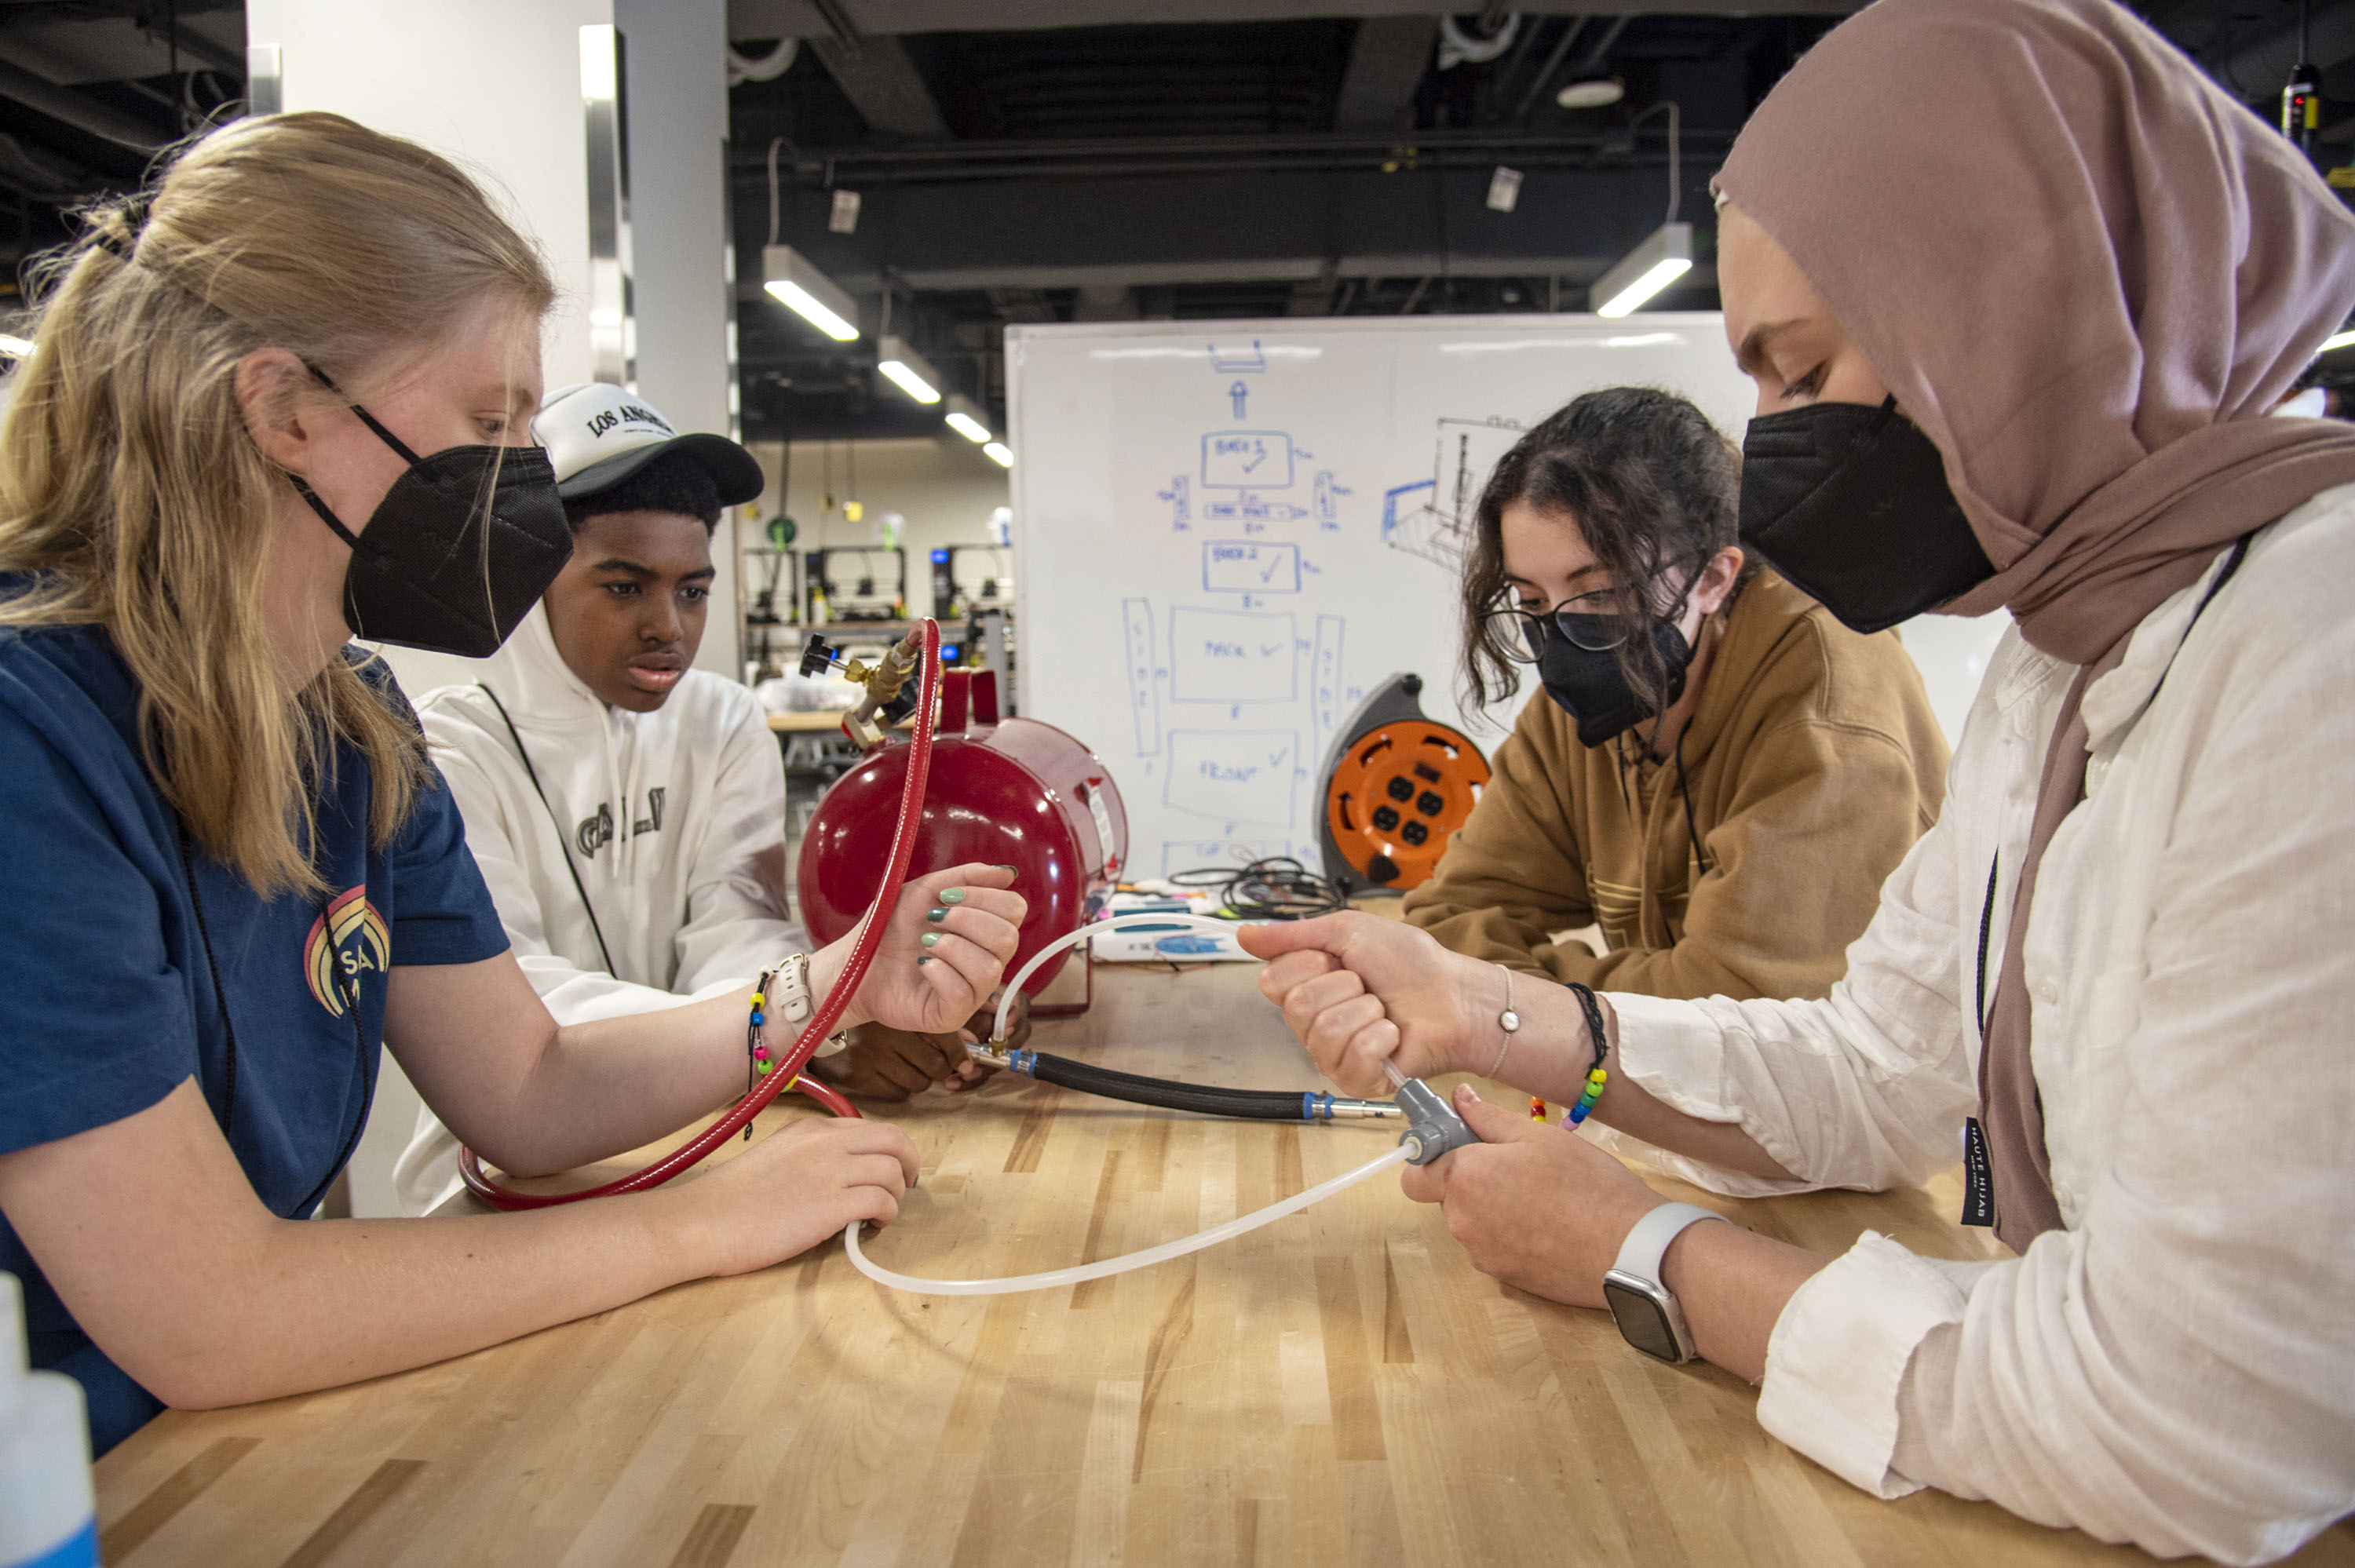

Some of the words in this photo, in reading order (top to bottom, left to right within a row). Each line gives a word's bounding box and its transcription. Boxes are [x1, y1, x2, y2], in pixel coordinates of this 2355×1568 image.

[586, 410, 619, 439] LOS
[619, 405, 675, 436] ANGE
[1971, 1127, 1984, 1171] HAUTE
[1977, 1177, 1986, 1217] HIJAB
